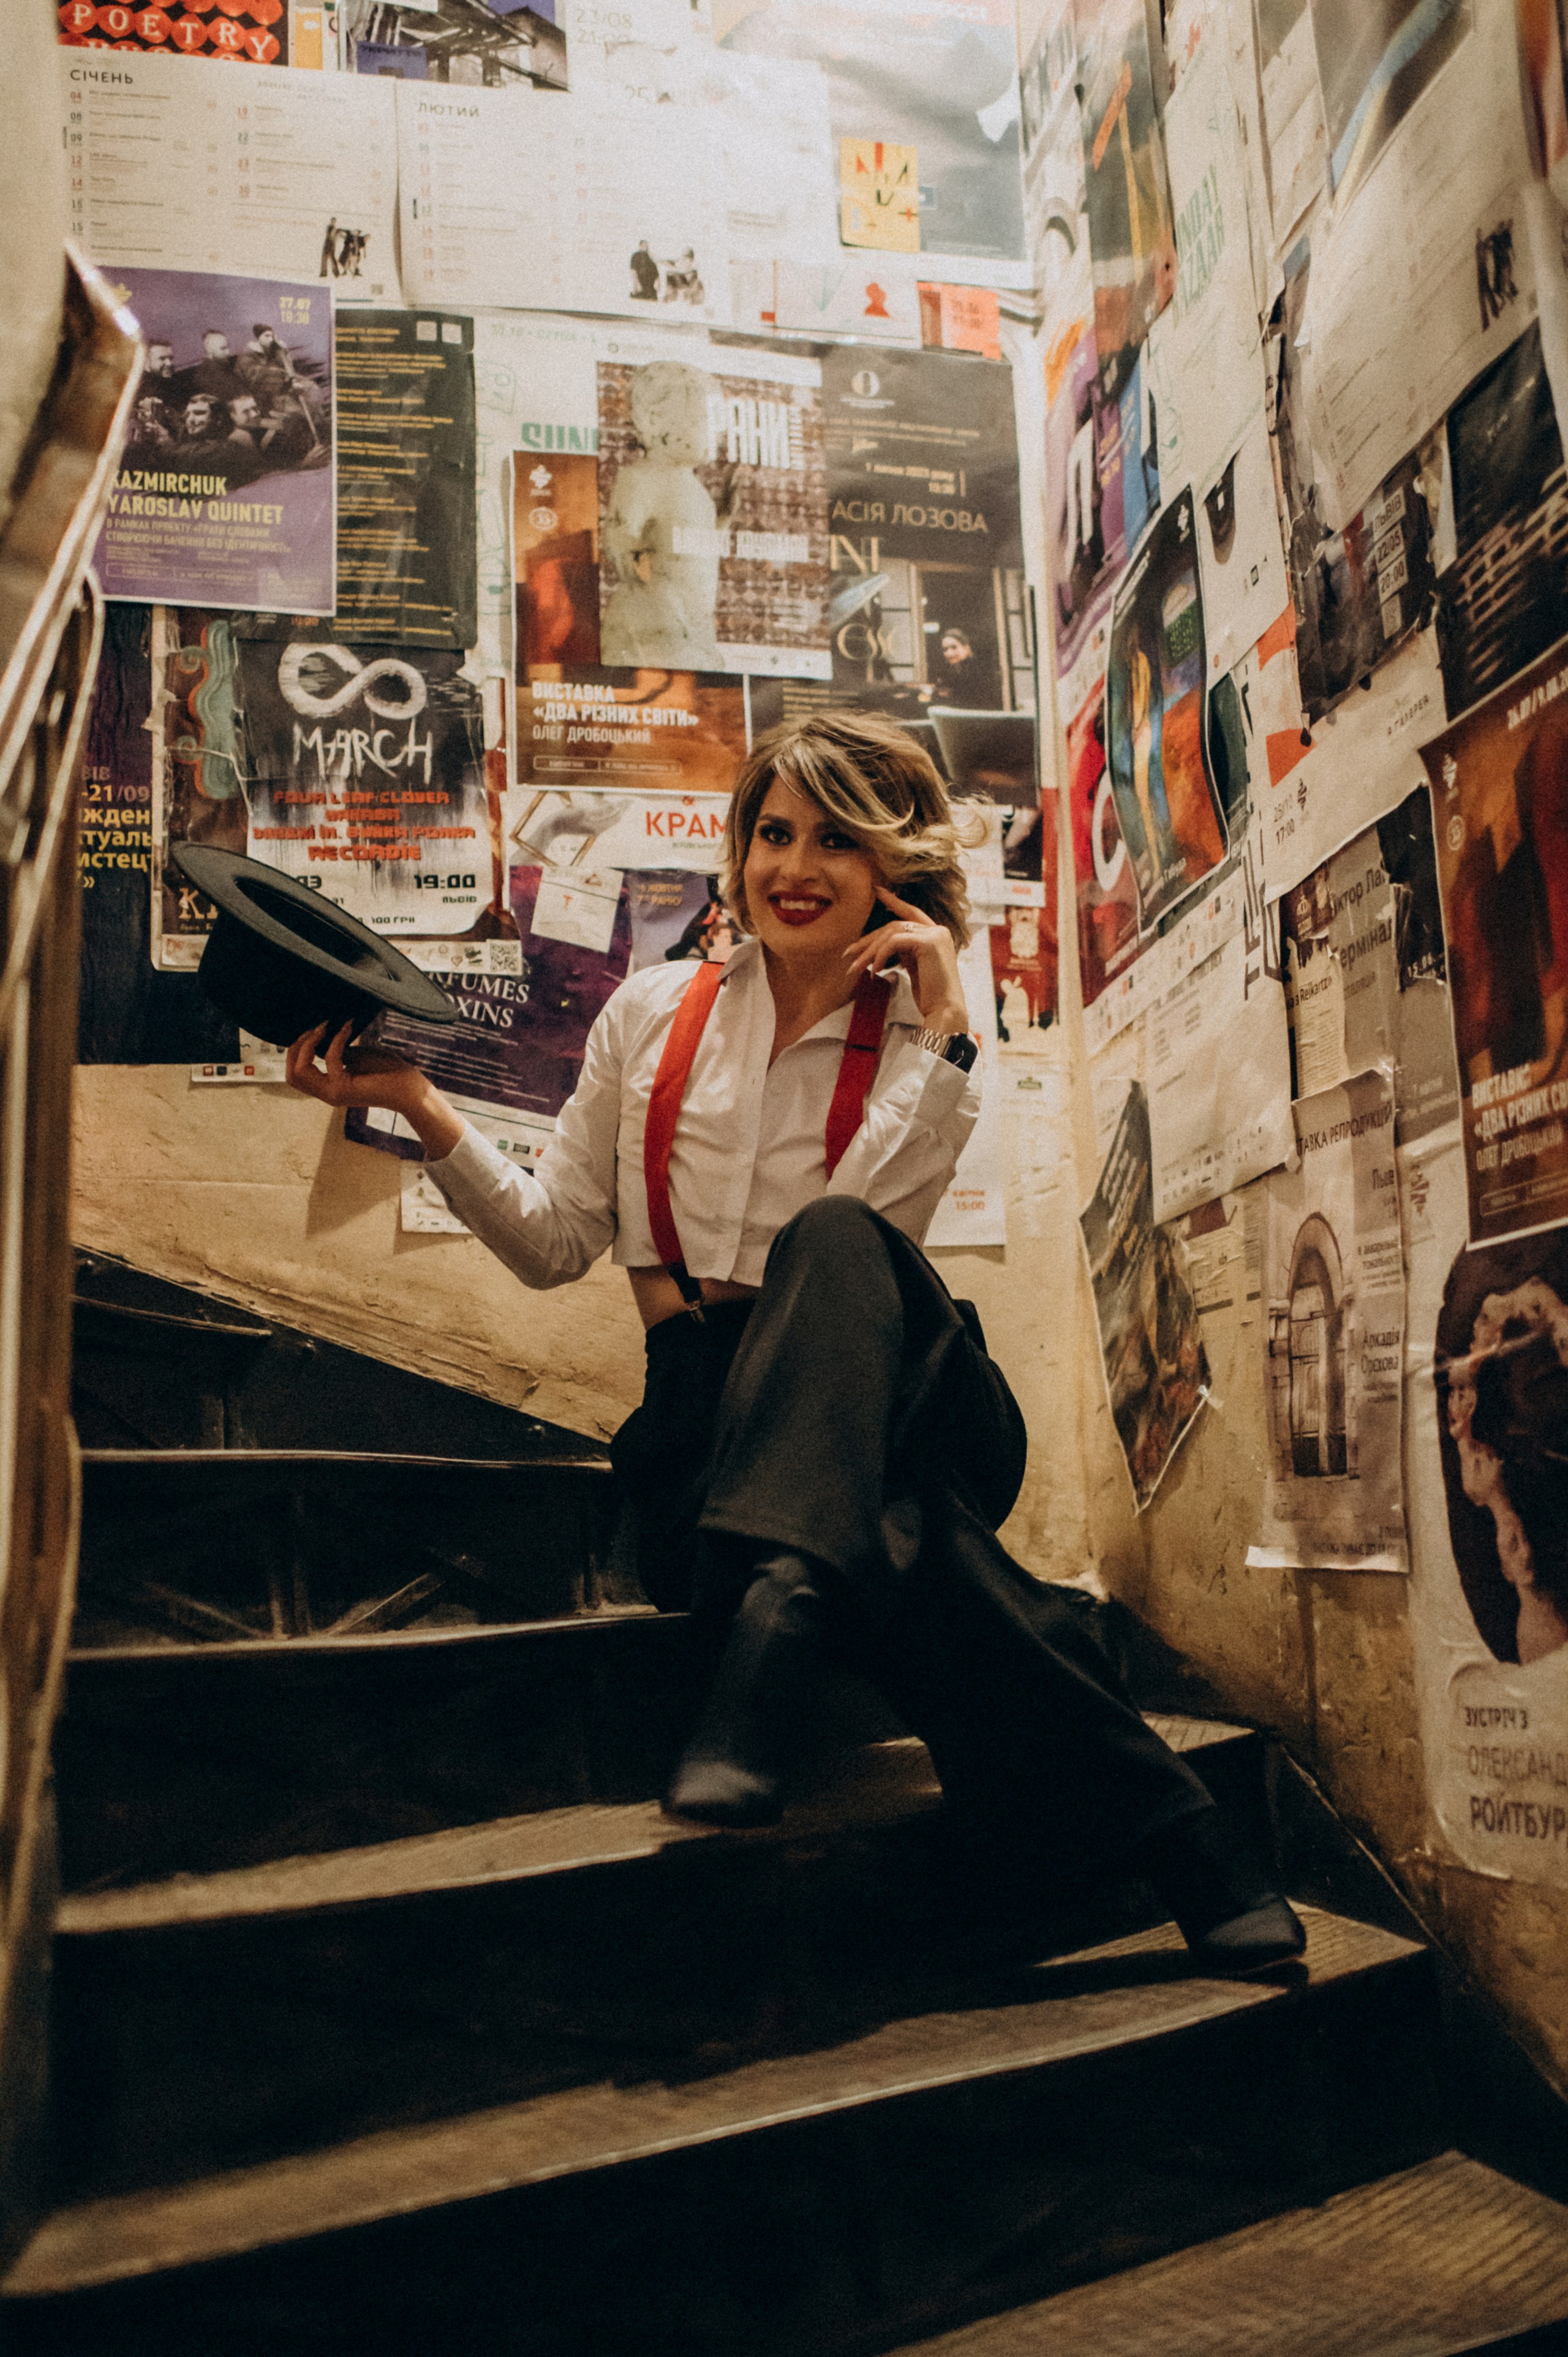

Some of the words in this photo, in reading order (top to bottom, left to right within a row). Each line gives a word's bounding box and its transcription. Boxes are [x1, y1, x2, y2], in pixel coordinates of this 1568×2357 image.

[73, 3, 273, 60] POETRY
[70, 69, 134, 85] СІЧЕНЬ
[418, 101, 480, 118] ЛЮТИЙ
[108, 494, 203, 519] YAROSLAV
[207, 500, 284, 525] QUINTET
[891, 503, 989, 534] ЛОЗОВА
[532, 681, 615, 704] ВИСТАВКА
[533, 701, 578, 723] «ДВА
[581, 704, 640, 726] РІЗНИХ
[642, 707, 699, 728] СВІТИ»
[532, 724, 565, 741] ОЛЕГ
[292, 715, 433, 785] MARCH
[413, 873, 476, 889] 19:00
[956, 1201, 986, 1211] 15:00
